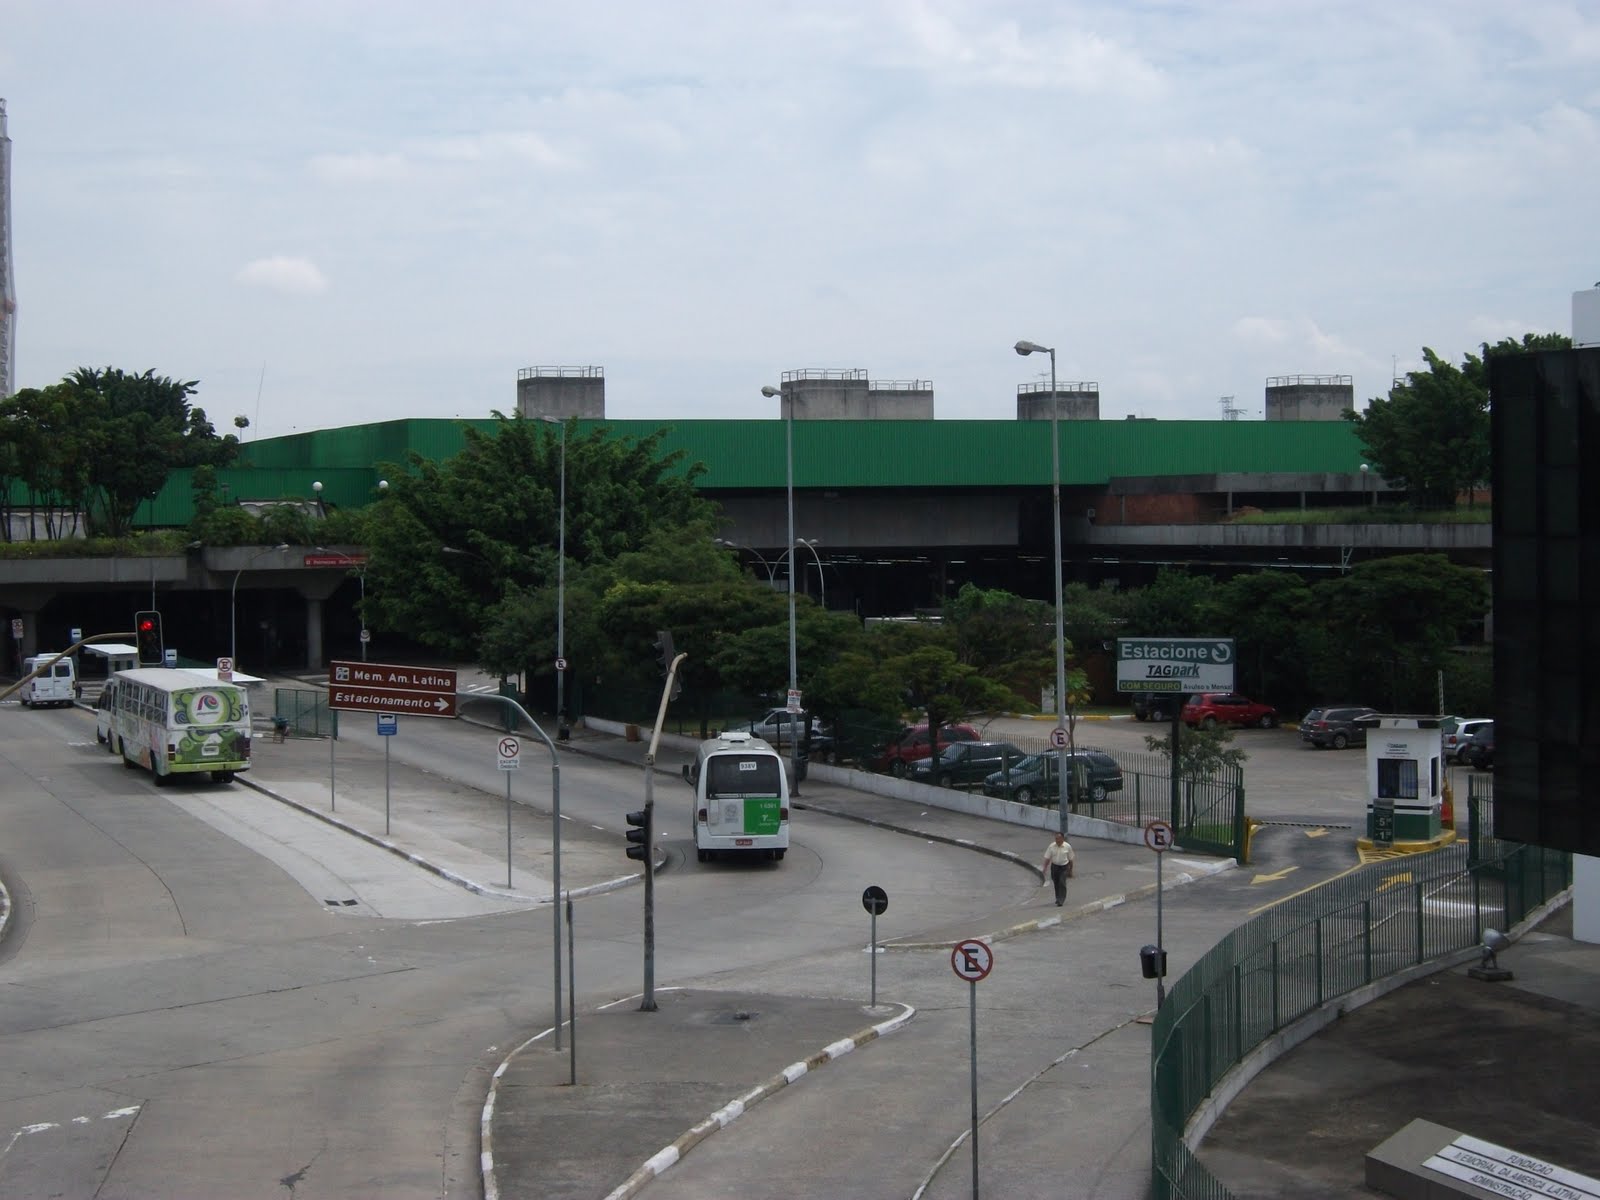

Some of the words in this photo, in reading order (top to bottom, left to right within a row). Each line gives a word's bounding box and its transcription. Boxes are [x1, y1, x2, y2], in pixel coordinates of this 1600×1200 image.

[1121, 643, 1208, 659] Estacione
[1146, 664, 1200, 678] TAGpark
[412, 674, 451, 687] Latina
[1121, 682, 1141, 690] COM
[1143, 682, 1180, 690] SEGURO
[335, 692, 431, 709] Estacionamento
[964, 948, 979, 972] E
